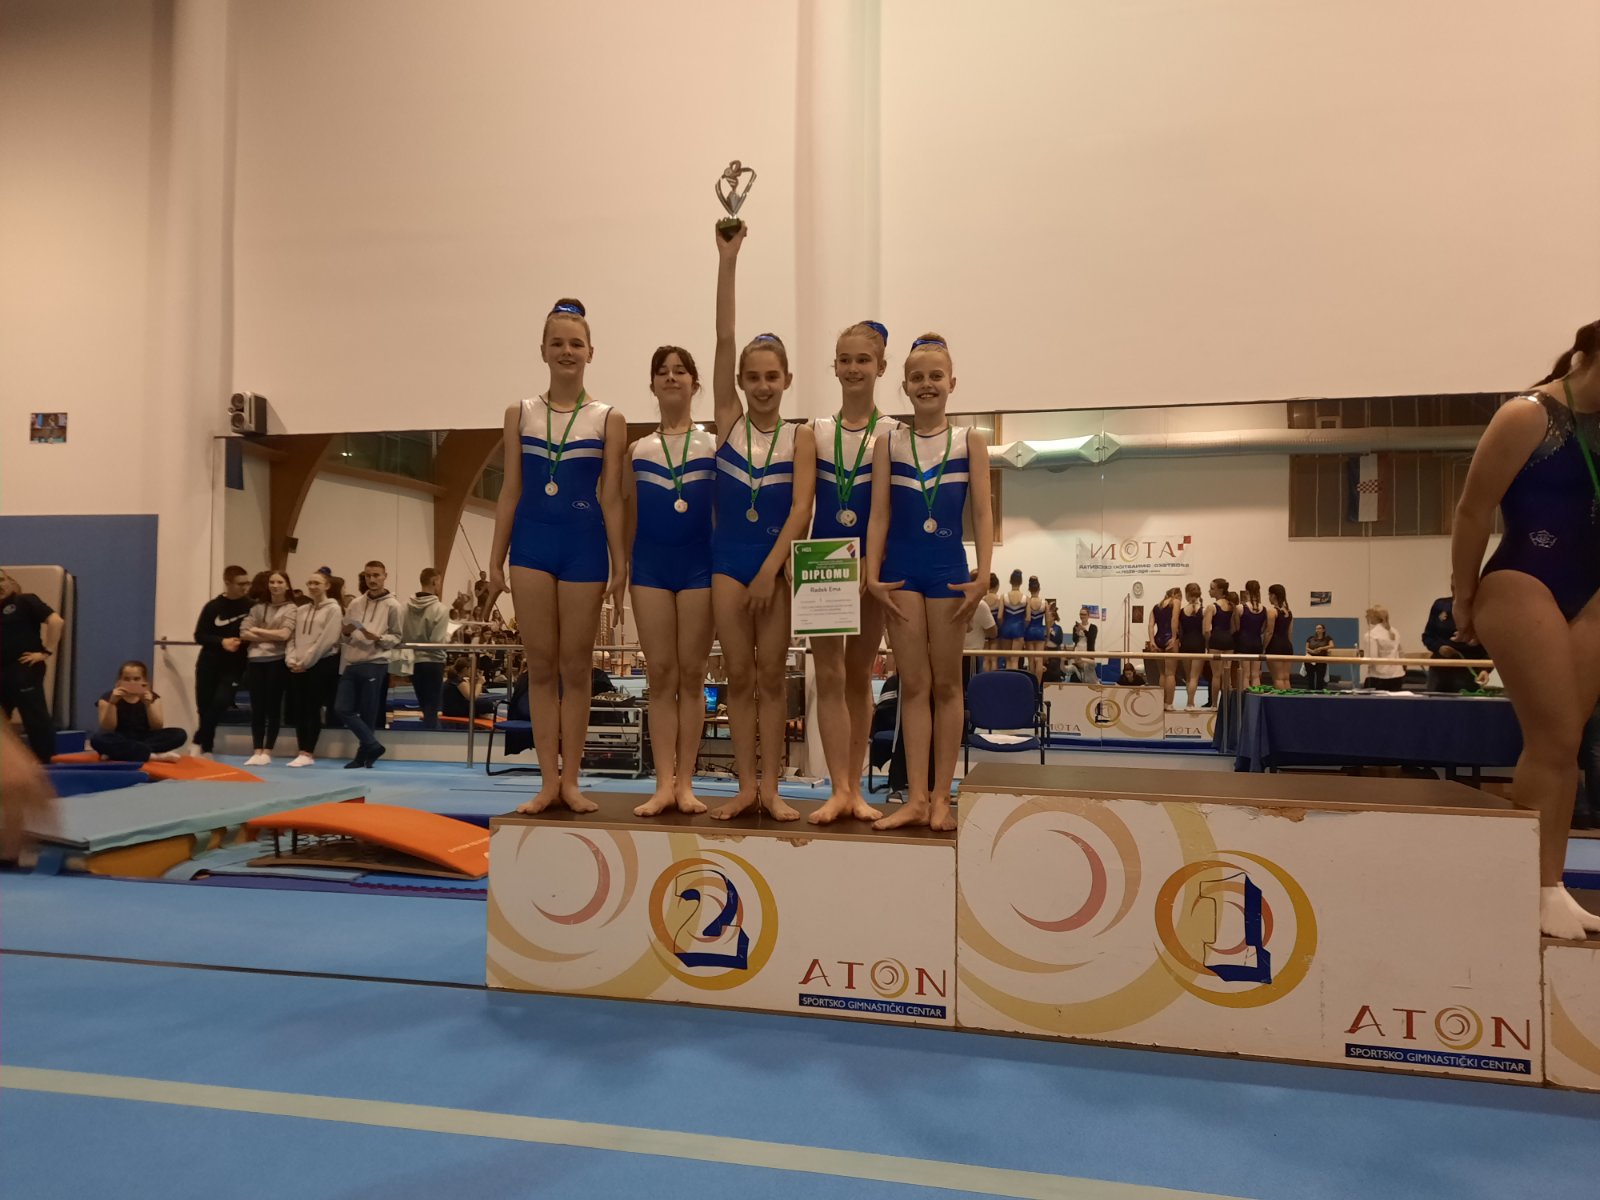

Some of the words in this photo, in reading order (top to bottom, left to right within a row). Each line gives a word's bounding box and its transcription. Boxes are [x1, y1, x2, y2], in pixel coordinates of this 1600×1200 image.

[801, 568, 850, 580] DIPLOMU
[673, 869, 750, 970] 2
[1199, 872, 1272, 984] 1
[798, 956, 946, 999] ATON
[802, 996, 846, 1008] SPORTSKO
[847, 1001, 905, 1014] GIMNASTIČKI
[906, 1006, 942, 1017] CENTAR
[1343, 1004, 1531, 1051] ATON
[1349, 1047, 1404, 1060] SPORTSKO
[1406, 1052, 1478, 1067] GIMNASTIČKI
[1480, 1059, 1526, 1072] CENTAR
